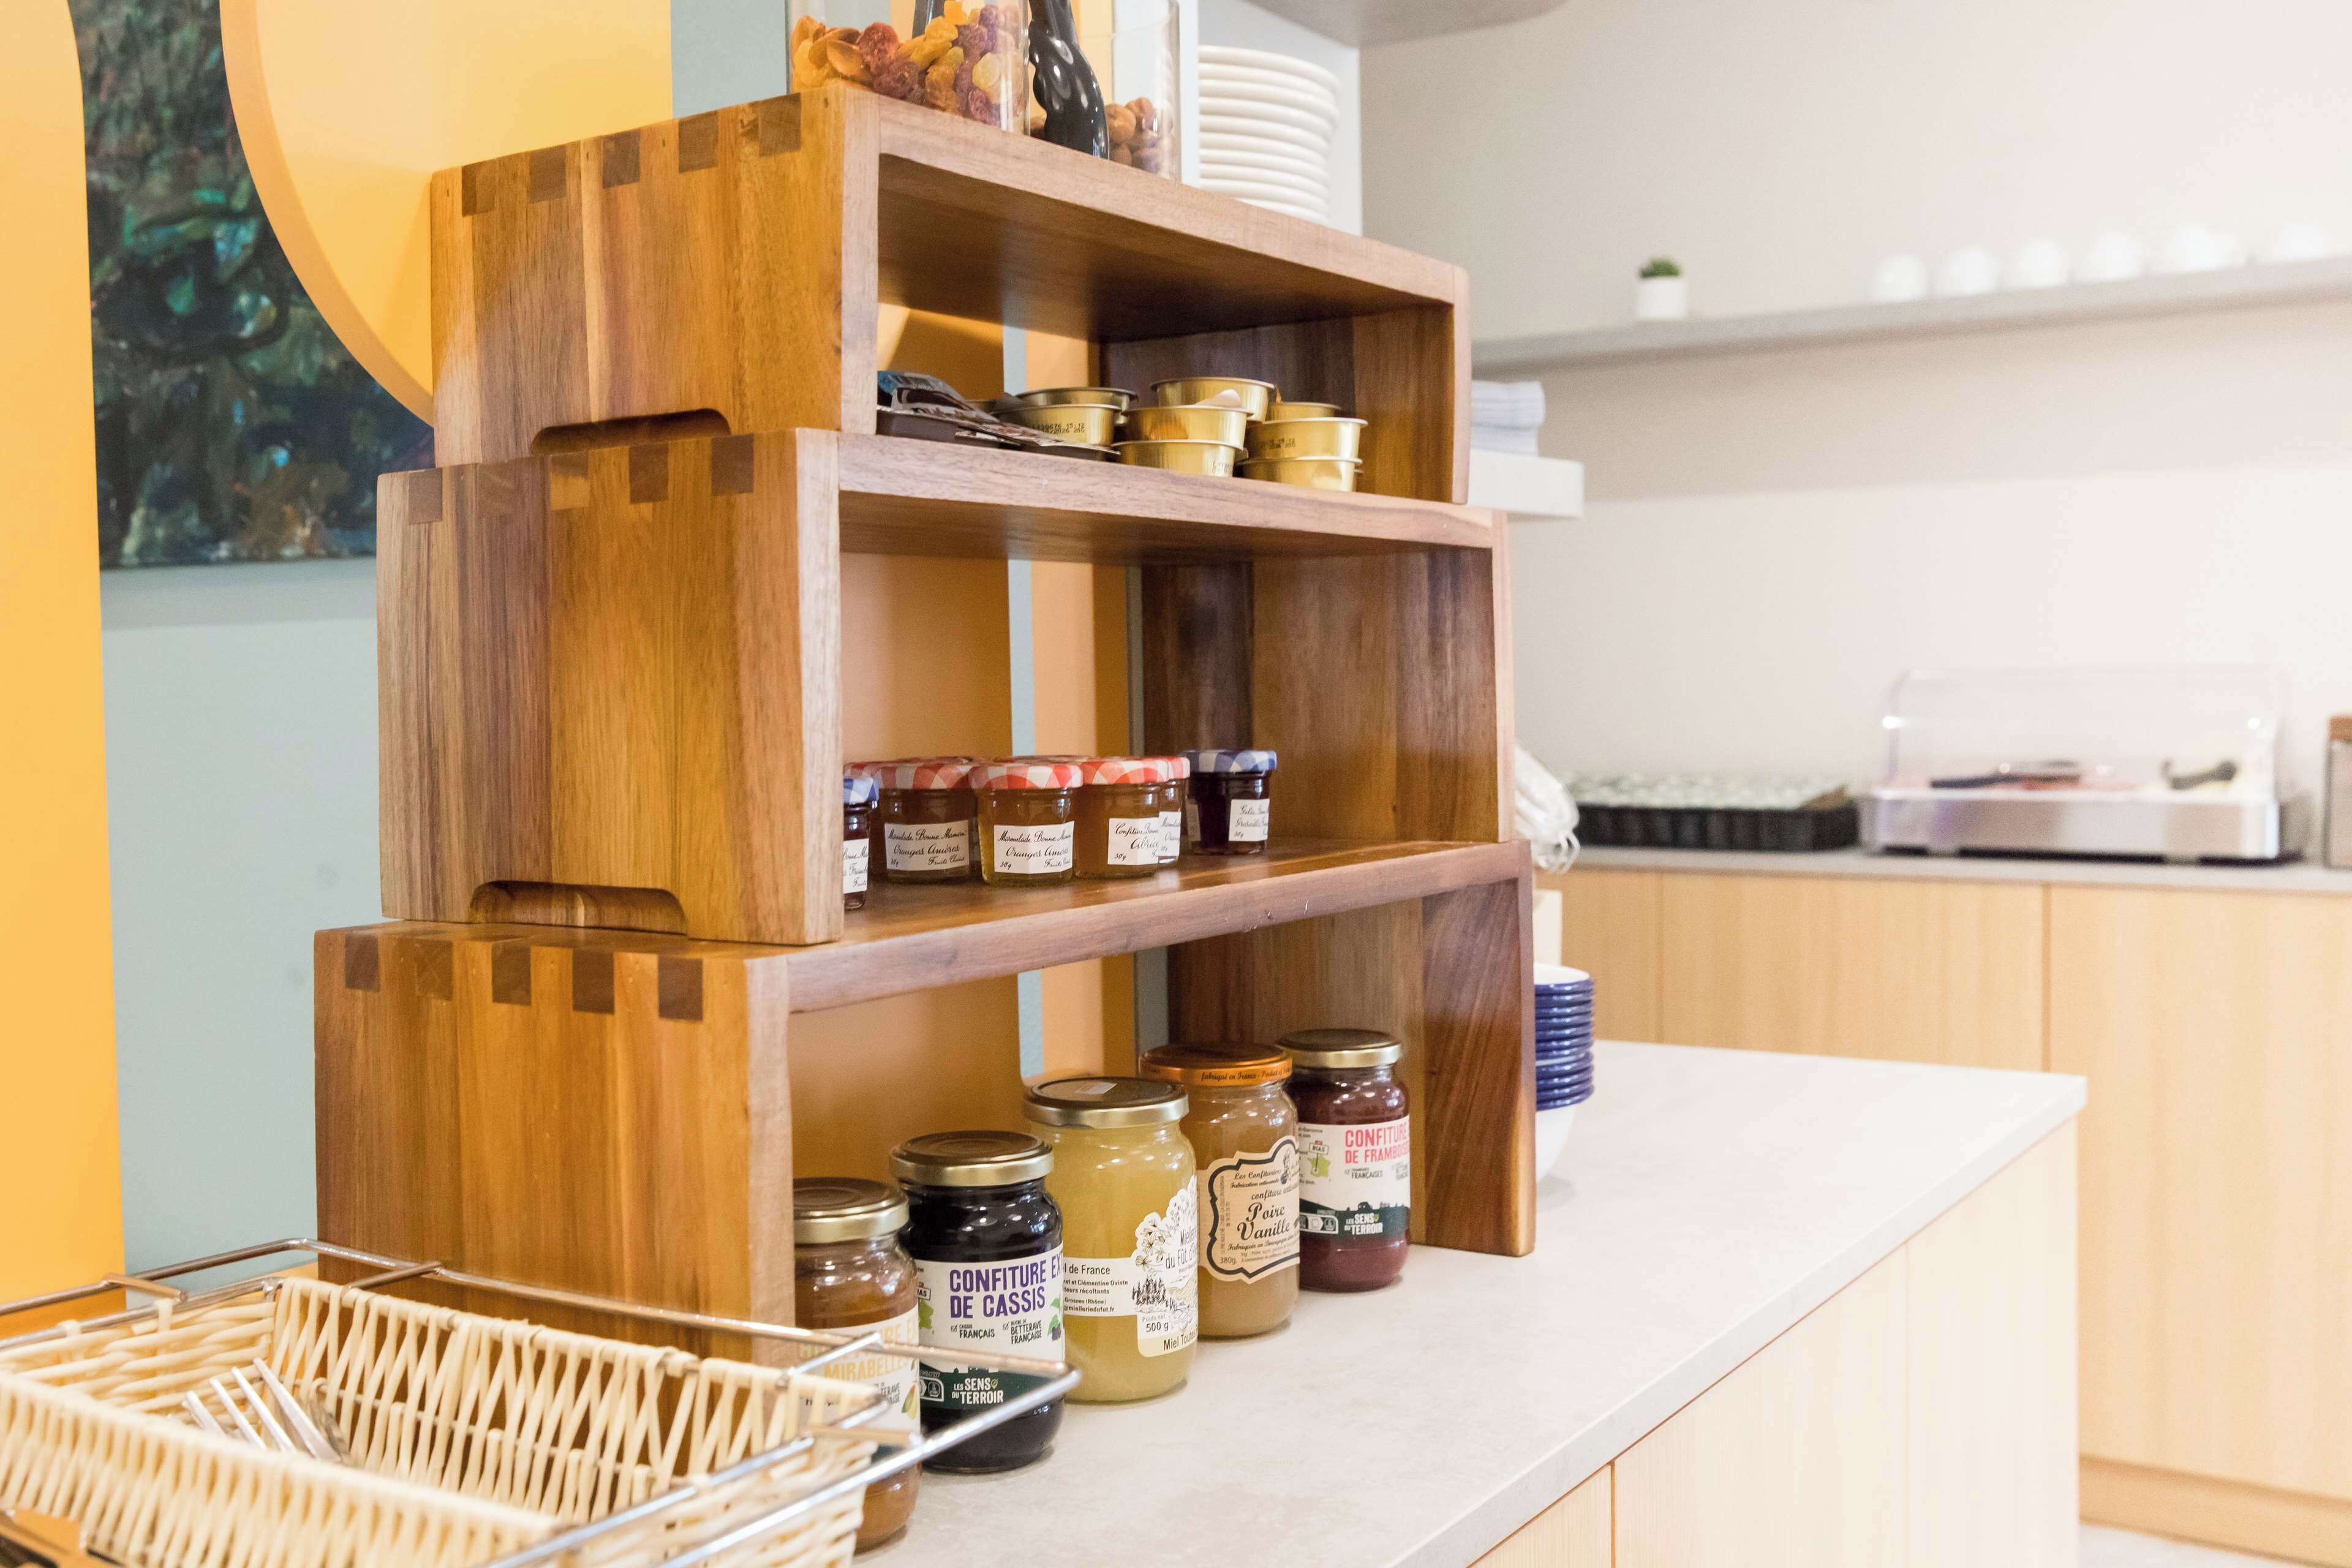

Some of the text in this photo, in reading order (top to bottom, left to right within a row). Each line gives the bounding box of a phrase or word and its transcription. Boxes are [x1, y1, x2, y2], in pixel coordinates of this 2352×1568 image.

[915, 828, 941, 841] Bonne
[998, 830, 1031, 843] Marmelade
[1033, 831, 1057, 843] Bonne
[894, 844, 924, 858] Oranges
[1006, 845, 1041, 861] Oranges
[1345, 1122, 1407, 1148] CONFITURE
[1345, 1150, 1359, 1164] DE
[1251, 1189, 1281, 1200] confiture
[1246, 1202, 1285, 1222] Poire
[1354, 1213, 1374, 1224] SENS
[1237, 1219, 1290, 1240] Vanille
[1351, 1223, 1383, 1235] TERROIR
[1166, 1253, 1175, 1268] du
[950, 1252, 1063, 1293] CONFITURE EX
[1069, 1264, 1079, 1274] de
[1081, 1265, 1110, 1275] France
[918, 1289, 927, 1297] IAS
[950, 1286, 1045, 1318] DE CASSIS
[959, 1329, 995, 1339] FRANÇAIS
[1011, 1320, 1042, 1335] BETTERAVE
[1146, 1322, 1169, 1333] 500 g
[1011, 1332, 1042, 1345] FRANÇAISE
[1164, 1336, 1180, 1351] Miel
[964, 1378, 991, 1391] SENS
[960, 1390, 1003, 1404] TERROIR
